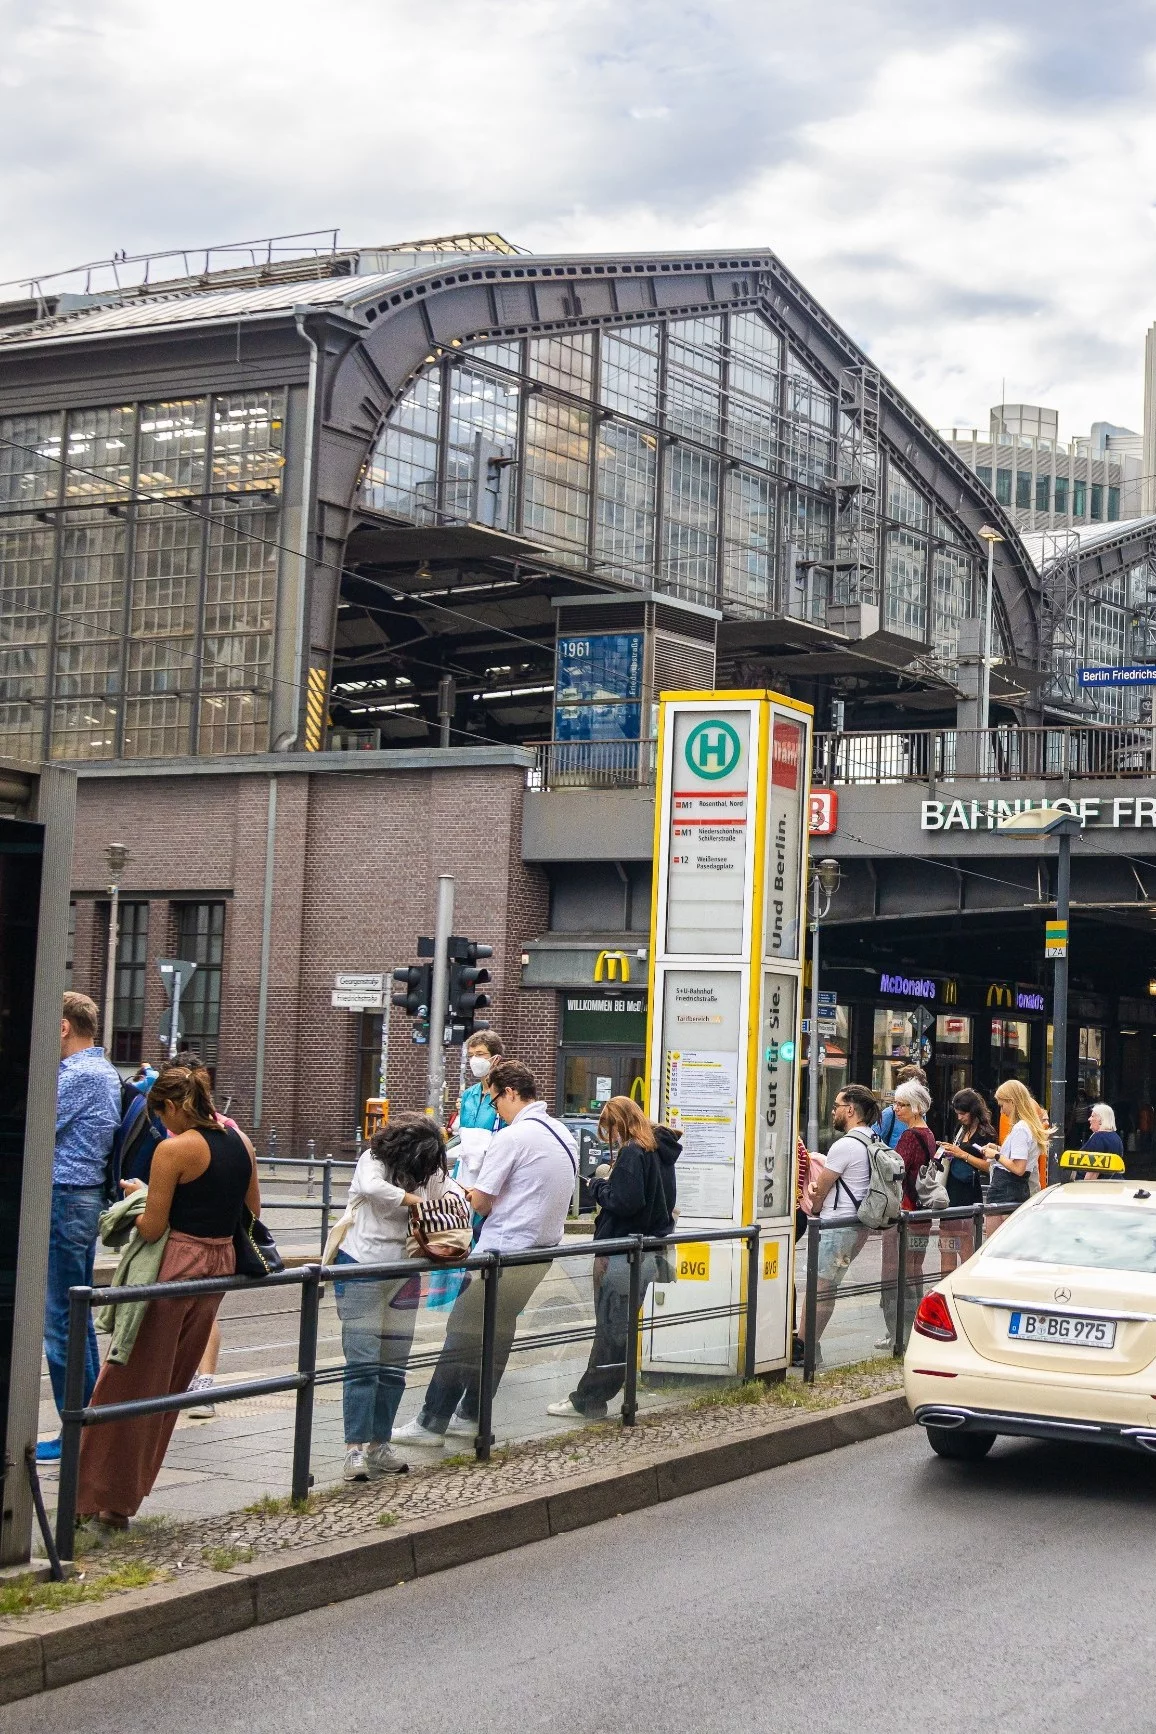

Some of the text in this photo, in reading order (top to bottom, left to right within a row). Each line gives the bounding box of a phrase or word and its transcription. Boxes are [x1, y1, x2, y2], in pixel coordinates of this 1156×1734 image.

[563, 641, 590, 658] 1961
[1082, 671, 1110, 681] Berlin
[699, 732, 727, 768] H
[681, 801, 693, 809] M1
[680, 855, 689, 864] 12
[772, 813, 787, 949] Und Berlin.
[880, 973, 936, 999] McDonald's
[567, 999, 613, 1012] WILLKOMMEN
[614, 1000, 625, 1012] BEI
[769, 985, 781, 1030] Sie.
[767, 1037, 780, 1074] für
[766, 1081, 778, 1127] Gut
[1069, 1153, 1111, 1169] TAXI
[763, 1156, 776, 1208] BVG
[680, 1260, 706, 1276] BVG
[765, 1260, 777, 1275] BVG
[1025, 1316, 1037, 1334] B
[1047, 1318, 1071, 1337] BG
[1074, 1321, 1107, 1341] 975
